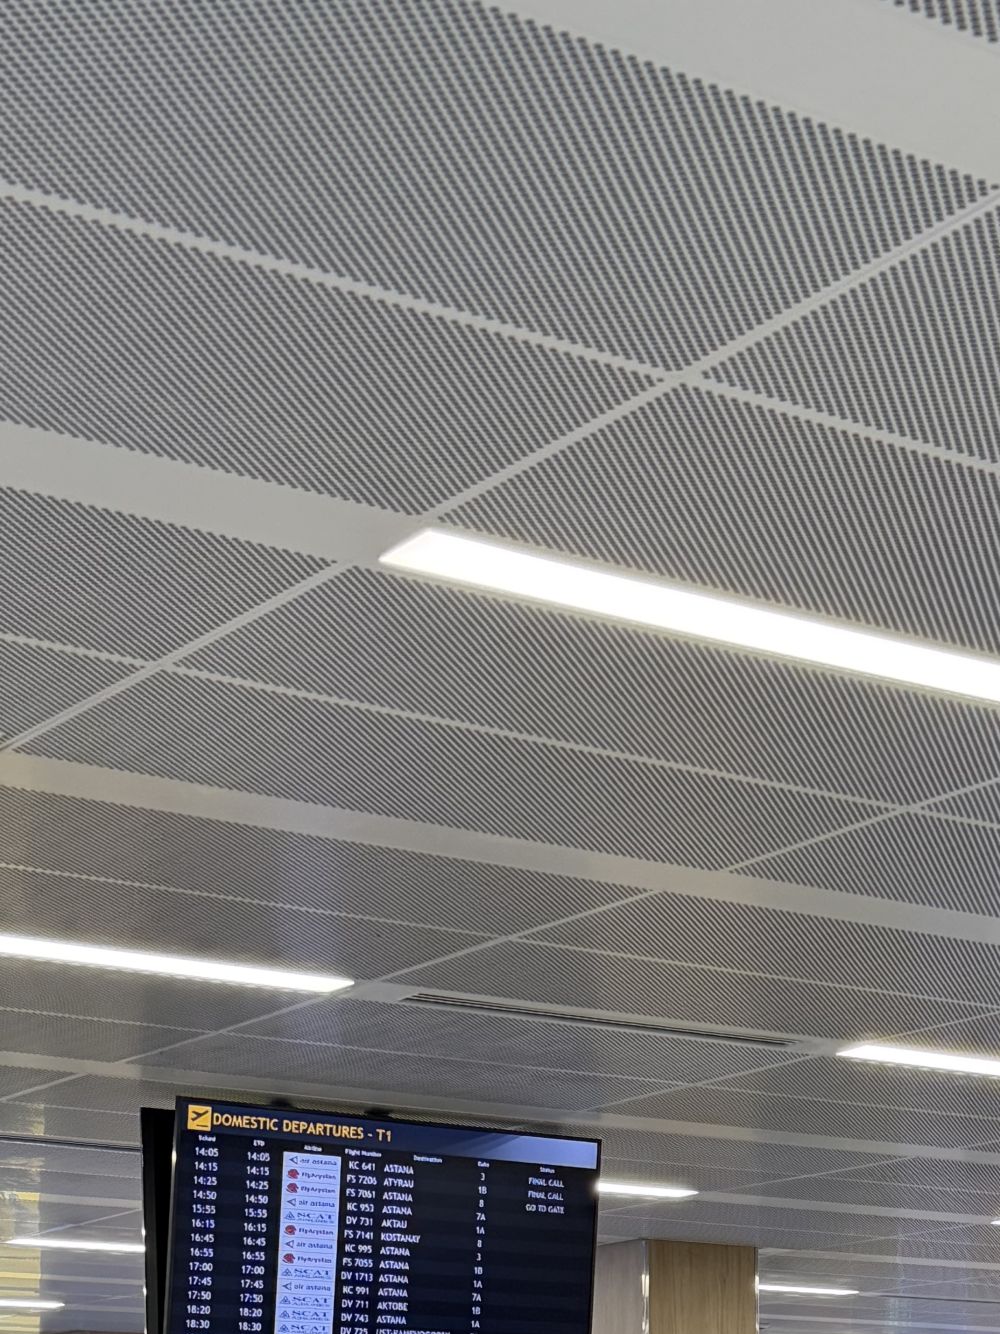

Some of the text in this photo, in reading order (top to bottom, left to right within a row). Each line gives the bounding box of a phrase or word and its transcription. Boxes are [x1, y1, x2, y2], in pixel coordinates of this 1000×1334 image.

[213, 1113, 278, 1131] DOMESTIC
[283, 1121, 363, 1140] DEPARTURES
[376, 1129, 392, 1143] T1
[195, 1147, 219, 1157] 14:05
[247, 1151, 270, 1162] 14:05
[344, 1148, 361, 1156] Flight
[194, 1161, 218, 1172] 14:15
[348, 1160, 376, 1171] KC 641
[384, 1164, 414, 1174] ASTANA
[246, 1166, 270, 1176] 14:15
[194, 1175, 218, 1186] 14:25
[346, 1174, 377, 1185] FS 7206
[480, 1172, 486, 1181] 3
[246, 1180, 269, 1190] 14:25
[383, 1177, 414, 1188] ATYRAU
[528, 1177, 565, 1188] FINAL CALL
[193, 1190, 217, 1200] 14:50
[346, 1188, 376, 1199] FS 7061
[478, 1186, 487, 1195] 1B
[527, 1190, 564, 1201] FINAL CALL
[245, 1194, 269, 1204] 14:50
[382, 1191, 413, 1202] ASTANA
[346, 1202, 374, 1212] KC 953
[479, 1199, 484, 1208] 8
[525, 1203, 565, 1214] GO TO GATE
[192, 1204, 216, 1214] 15:55
[244, 1208, 268, 1218] 15:55
[382, 1205, 413, 1215] ASTANA
[346, 1215, 373, 1226] DV 731
[476, 1212, 486, 1221] 7A
[191, 1218, 215, 1229] 16:15
[244, 1222, 267, 1233] 16:15
[381, 1219, 408, 1229] AKTAU
[344, 1229, 374, 1240] FS 7141
[476, 1226, 485, 1235] 1A
[191, 1233, 215, 1243] 16:45
[243, 1237, 266, 1247] 16:45
[380, 1232, 421, 1243] KOSTANAY
[344, 1243, 373, 1254] KC 995
[477, 1239, 482, 1248] 8
[190, 1247, 214, 1258] 16:55
[242, 1251, 265, 1261] 16:55
[380, 1246, 410, 1256] ASTANA
[476, 1252, 482, 1261] 3
[189, 1261, 213, 1272] 17:00
[342, 1257, 373, 1268] FS 7055
[379, 1260, 410, 1270] ASTANA
[241, 1265, 265, 1275] 17:00
[474, 1266, 483, 1275] 1B
[188, 1276, 212, 1286] 17:45
[340, 1271, 353, 1280] DV
[355, 1272, 373, 1282] 1713
[378, 1274, 409, 1284] ASTANA
[241, 1279, 264, 1289] 17:45
[473, 1280, 483, 1289] 1A
[188, 1290, 212, 1300] 17:50
[342, 1285, 369, 1295] KC 991
[378, 1287, 408, 1297] ASTANA
[240, 1293, 264, 1303] 17:50
[472, 1292, 482, 1302] 7A
[341, 1299, 369, 1308] DV 711
[377, 1301, 408, 1311] AKTOBE
[187, 1305, 211, 1315] 18:20
[239, 1307, 263, 1317] 18:20
[471, 1306, 481, 1315] 1B
[340, 1313, 353, 1322] DV
[354, 1313, 369, 1323] 743
[376, 1315, 407, 1325] ASTANA
[186, 1319, 210, 1329] 18:30
[238, 1321, 262, 1331] 18:30
[471, 1320, 480, 1328] 1A
